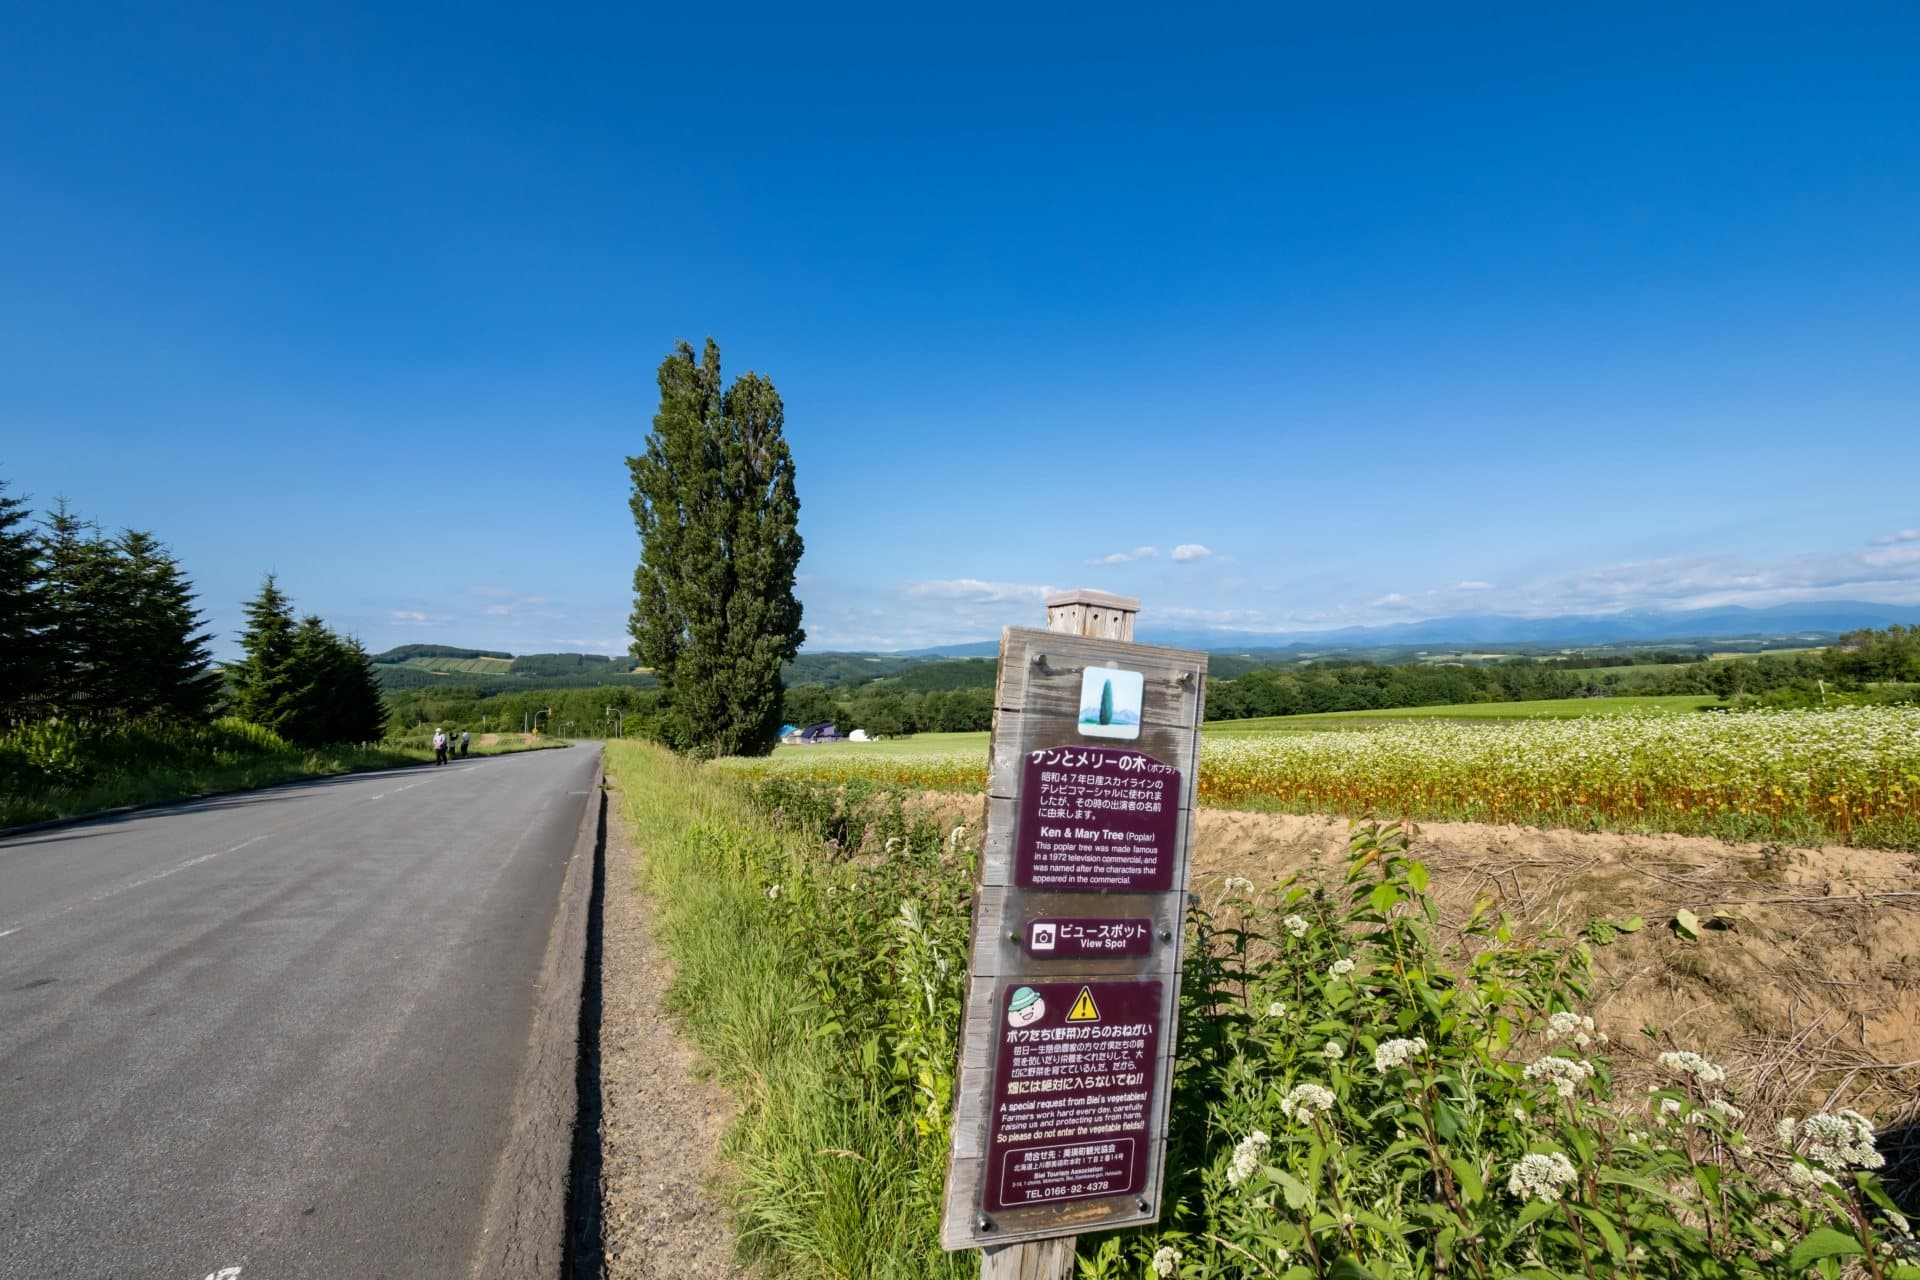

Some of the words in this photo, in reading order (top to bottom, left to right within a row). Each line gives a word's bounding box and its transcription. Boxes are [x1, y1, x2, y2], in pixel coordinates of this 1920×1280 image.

[1032, 750, 1146, 772] ケンとメリーの木
[1041, 784, 1162, 800] テレビコマーシャルに使われま
[1040, 796, 1161, 812] したが、その時の出演者の名前
[1039, 808, 1096, 820] に由来します。
[1041, 826, 1061, 838] Ken
[1064, 828, 1072, 838] &
[1075, 828, 1099, 841] Mary
[1102, 829, 1123, 840] Tree
[1126, 832, 1155, 842] (Poplar)
[1036, 842, 1051, 850] This
[1053, 843, 1076, 851] poplar
[1079, 843, 1092, 851] tree
[1112, 844, 1130, 853] made
[1133, 845, 1157, 854] famous
[1035, 852, 1041, 860] in
[1050, 853, 1066, 861] 1972
[1068, 853, 1100, 862] television
[1102, 855, 1142, 864] commercial,
[1050, 863, 1074, 871] named
[1076, 864, 1092, 873] after
[1094, 865, 1105, 873] the
[1106, 865, 1141, 874] characters
[1144, 866, 1156, 874] that
[1032, 875, 1066, 883] appeared
[1076, 875, 1088, 883] the
[1090, 876, 1131, 884] commercial.
[1061, 924, 1146, 938] ビュースポット
[1080, 939, 1102, 948] View
[1105, 939, 1126, 949] Spot
[1000, 1104, 1006, 1112] A
[1008, 1100, 1035, 1111] special
[1037, 1098, 1066, 1109] request
[1068, 1097, 1084, 1105] from
[1087, 1095, 1105, 1104] Biei's
[1107, 1091, 1147, 1103] vegetables!
[1002, 1112, 1034, 1122] Farmers
[1036, 1110, 1054, 1119] work
[1057, 1108, 1074, 1117] hard
[1076, 1108, 1096, 1116] every
[1113, 1103, 1143, 1112] carefully
[1001, 1122, 1027, 1131] raising
[1056, 1116, 1092, 1126] protecting
[997, 1134, 1007, 1143] So
[1008, 1131, 1032, 1142] please
[1034, 1130, 1042, 1139] do
[1044, 1129, 1055, 1137] not
[1057, 1128, 1075, 1137] enter
[1077, 1126, 1087, 1134] the
[1089, 1122, 1121, 1134] vegetable
[1123, 1120, 1144, 1130] fields!!
[1071, 1166, 1103, 1175] Association
[1025, 1189, 1042, 1198] TEL
